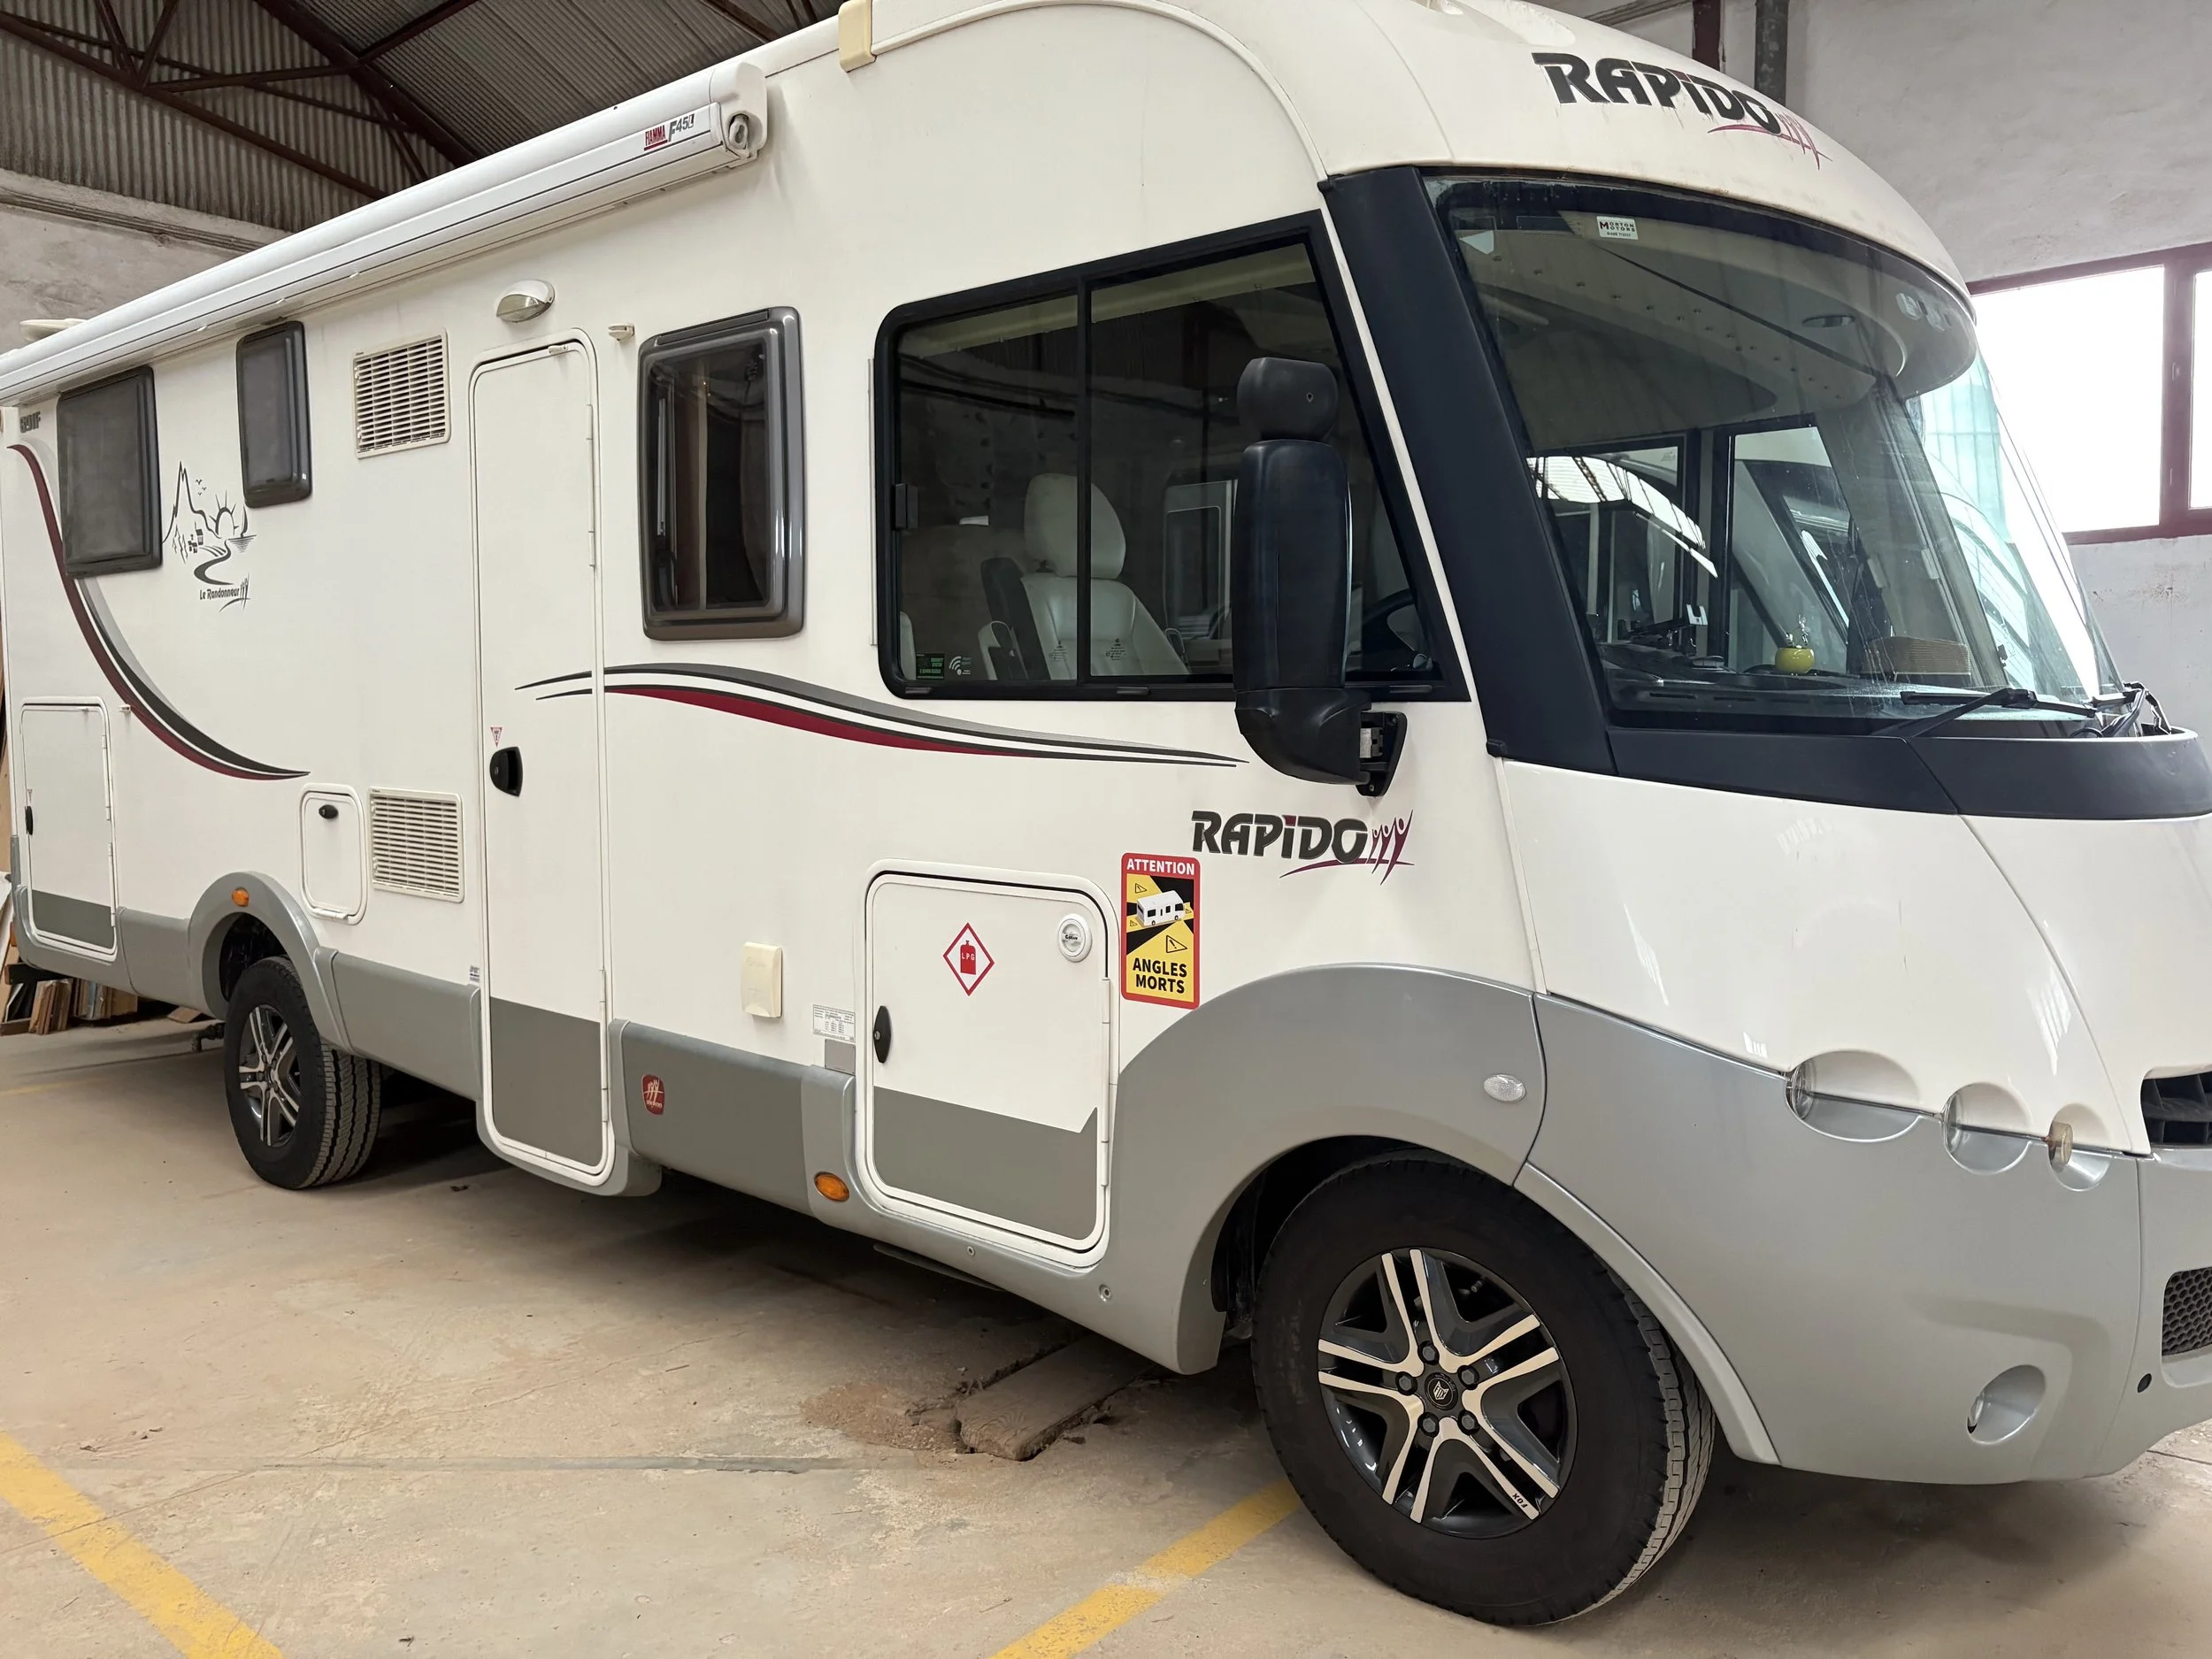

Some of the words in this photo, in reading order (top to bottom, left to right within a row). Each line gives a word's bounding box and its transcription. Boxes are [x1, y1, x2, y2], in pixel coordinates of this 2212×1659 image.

[645, 125, 666, 146] FIAMMA
[200, 589, 205, 600] Le
[1126, 858, 1194, 876] ATTENTION
[962, 952, 975, 961] LPG
[1133, 957, 1187, 978] ANGLES
[1135, 974, 1185, 994] MORTS
[1513, 1493, 1528, 1509] FOX
